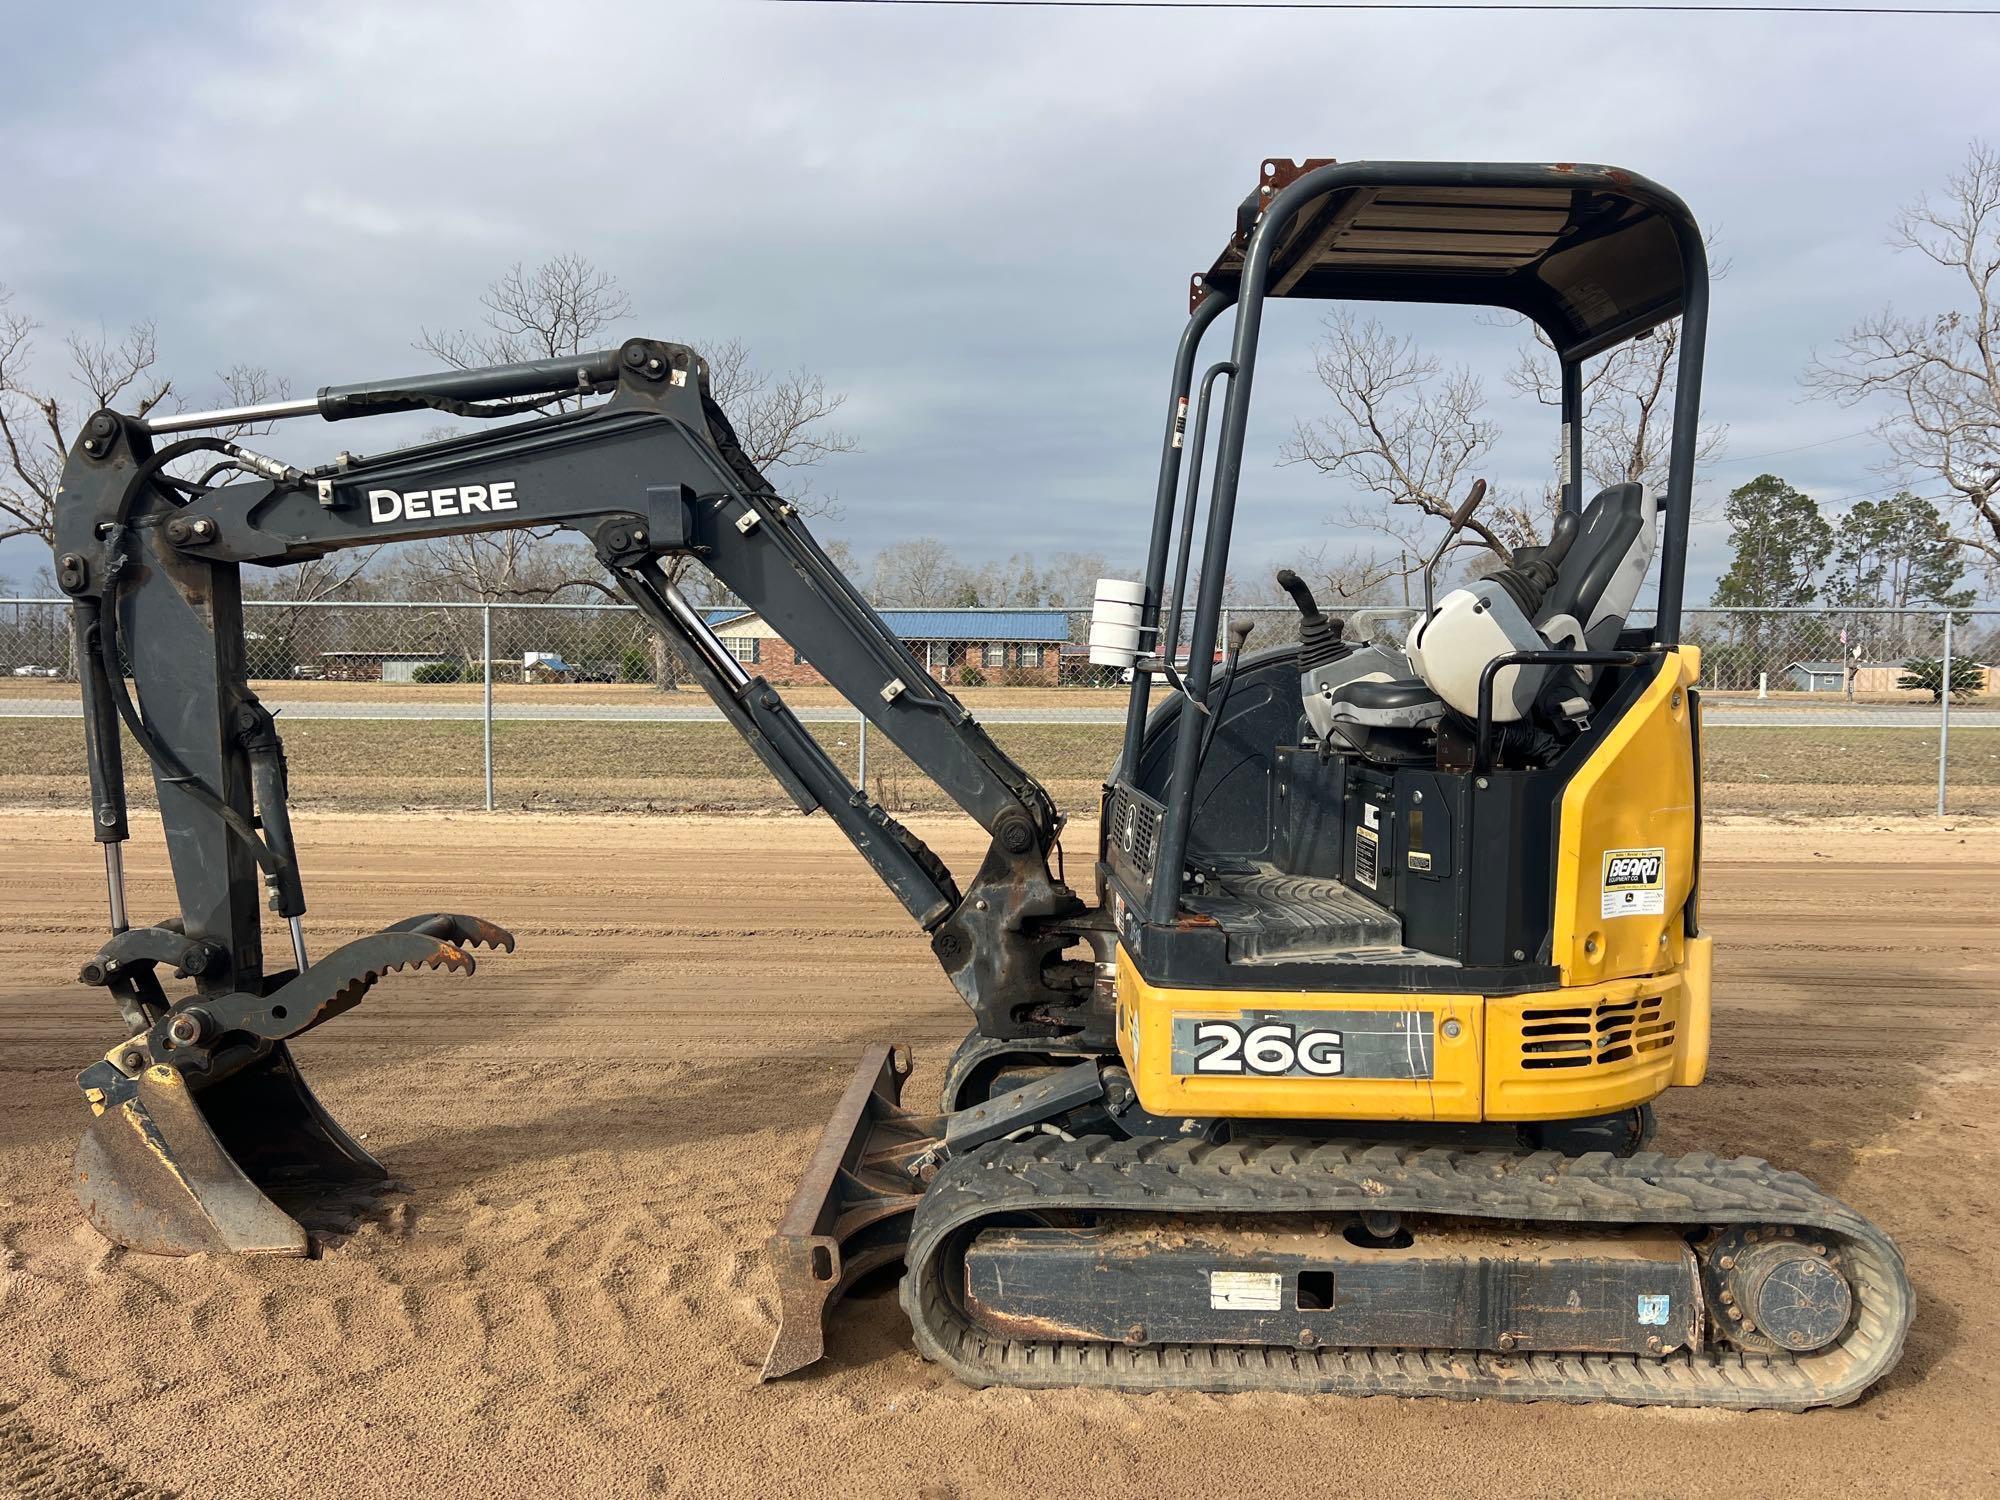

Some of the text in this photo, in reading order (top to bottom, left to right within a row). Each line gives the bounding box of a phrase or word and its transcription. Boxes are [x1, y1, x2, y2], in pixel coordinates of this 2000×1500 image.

[368, 481, 518, 524] DEERE
[1609, 858, 1658, 884] BEARD
[1196, 1022, 1343, 1075] 26G
